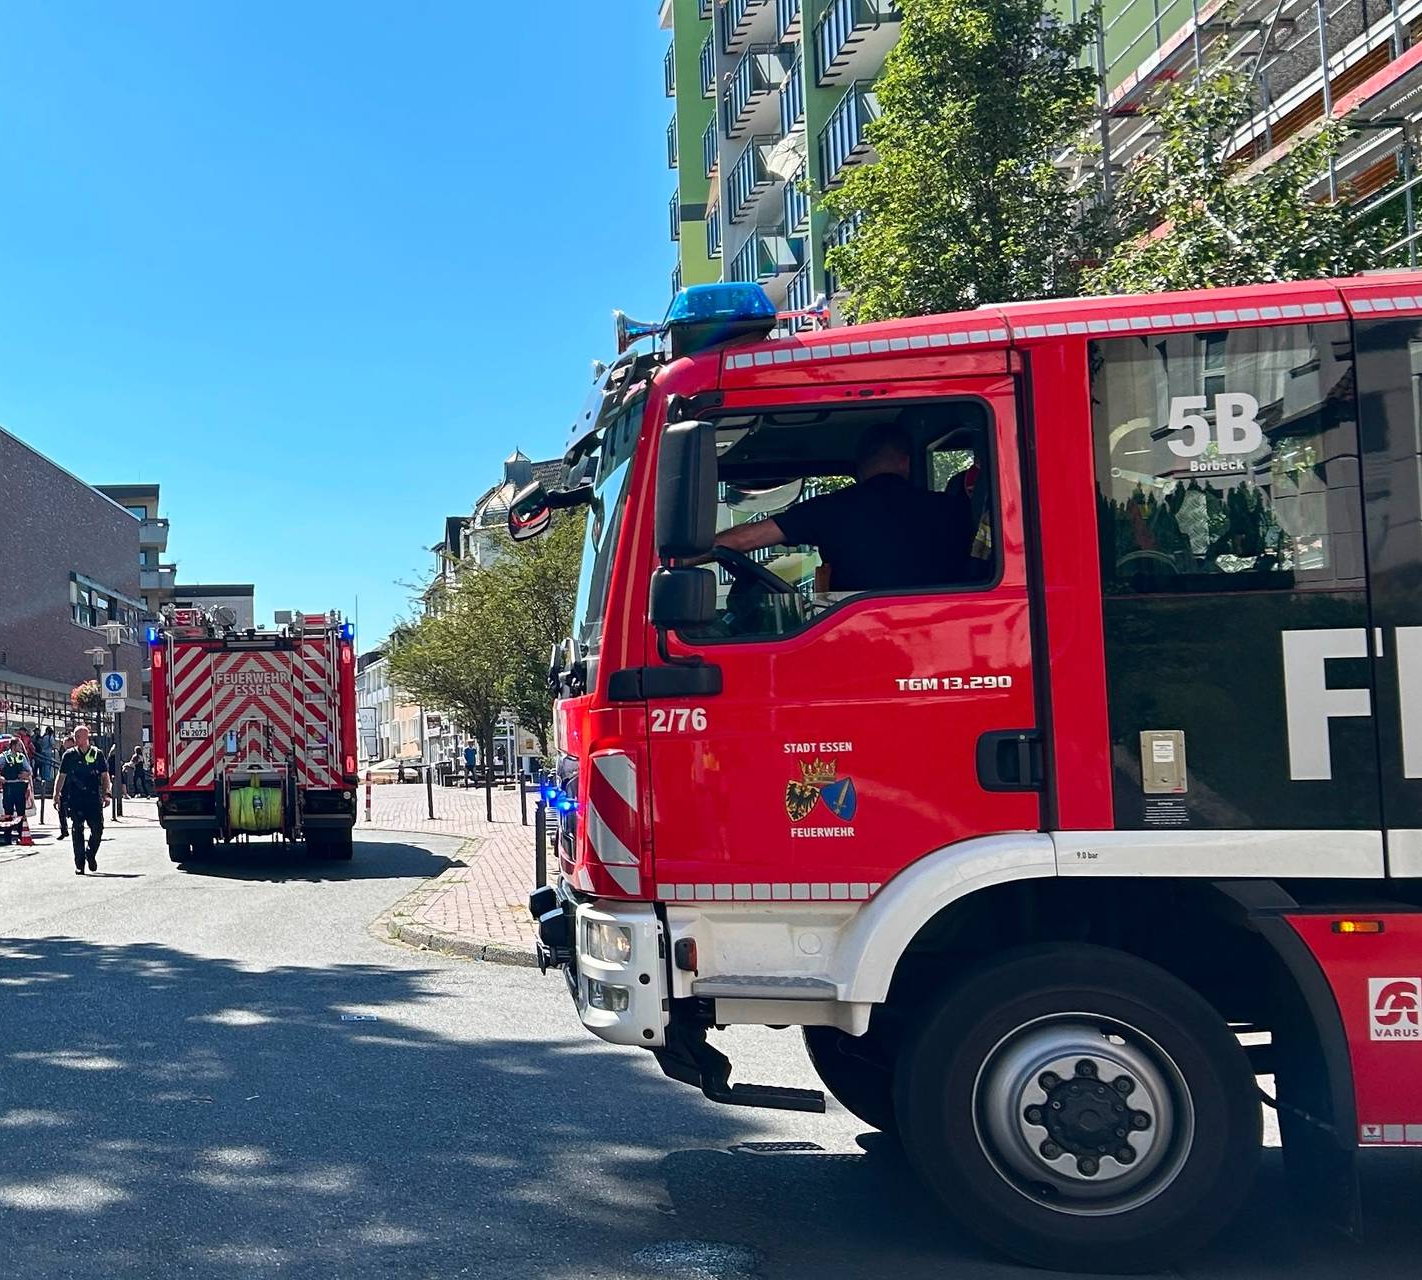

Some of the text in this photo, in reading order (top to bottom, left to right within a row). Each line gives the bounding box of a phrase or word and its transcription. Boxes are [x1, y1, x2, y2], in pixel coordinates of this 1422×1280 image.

[1167, 392, 1263, 457] 5B
[1190, 460, 1245, 472] Borbeck
[216, 671, 289, 685] FEUERWEHR
[895, 675, 1012, 691] TGM 13.290
[234, 684, 271, 696] ESSEN
[651, 708, 707, 732] 2/76
[784, 743, 853, 753] STADT ESSEN
[791, 827, 855, 838] FEUERWEHR
[1087, 851, 1098, 859] bar
[1374, 1029, 1419, 1037] VARUS
